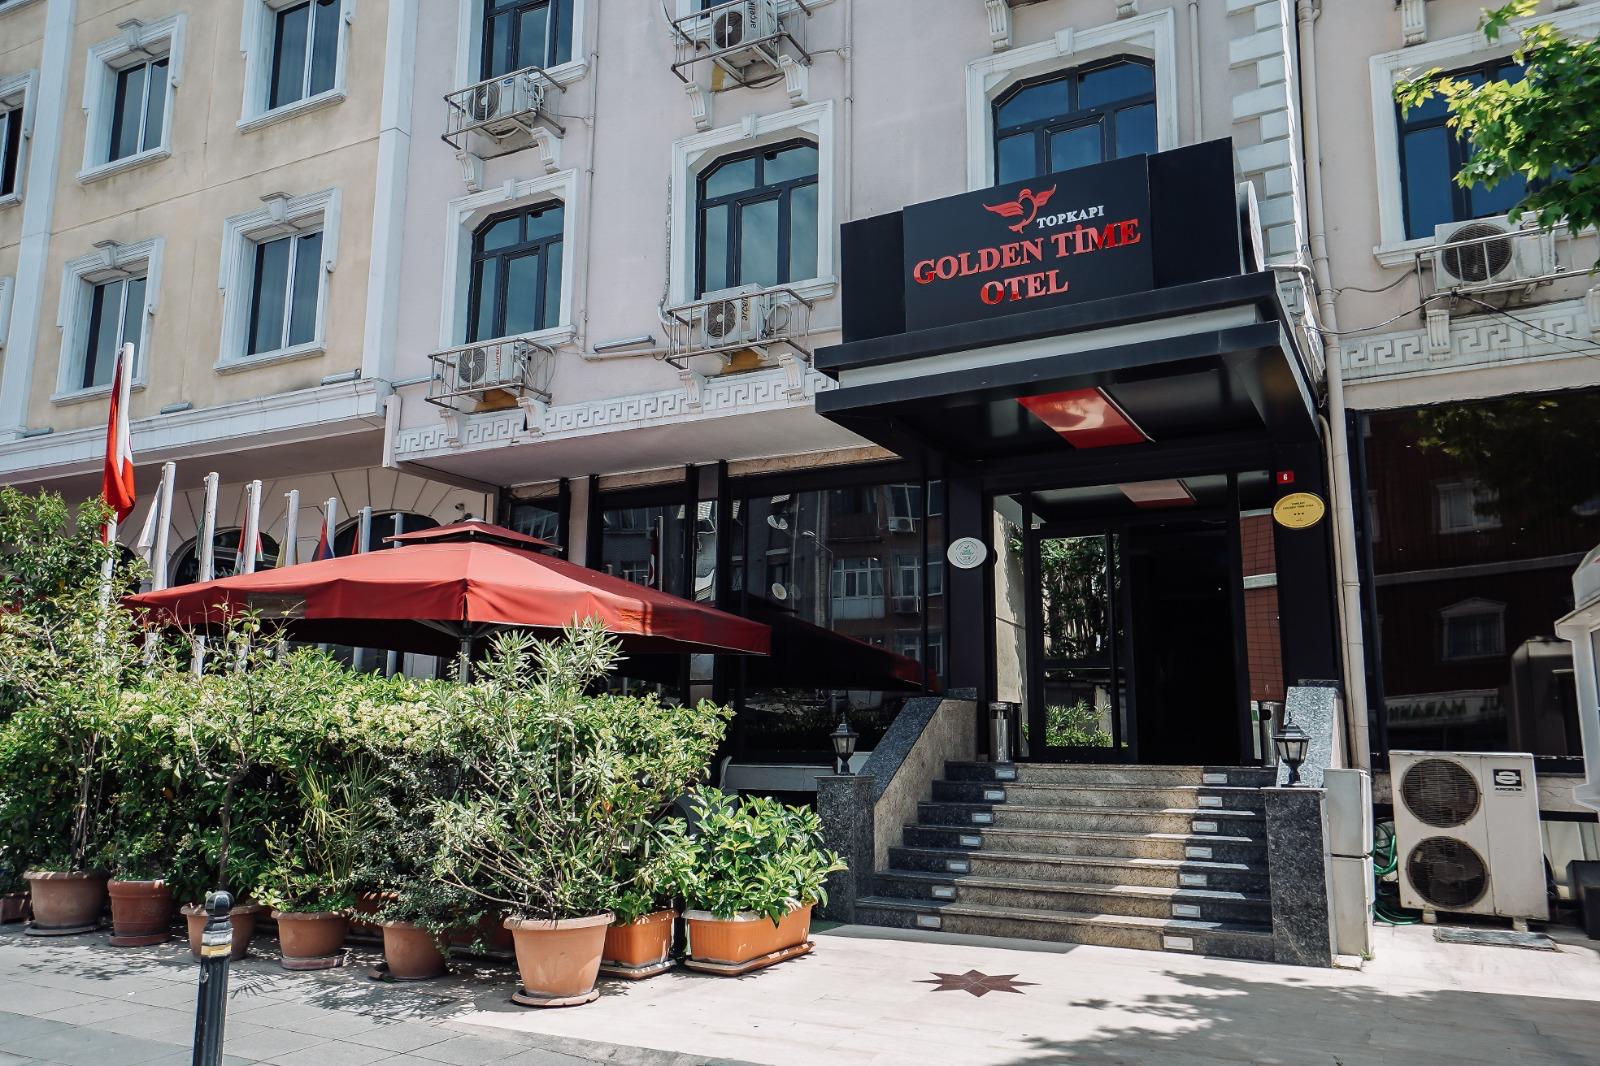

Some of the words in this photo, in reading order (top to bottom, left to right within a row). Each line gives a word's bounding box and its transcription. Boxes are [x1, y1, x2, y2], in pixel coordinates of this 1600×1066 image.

[1036, 205, 1104, 229] TOPKAPI
[913, 237, 1043, 285] GOLDEN
[980, 269, 1069, 305] OTEL
